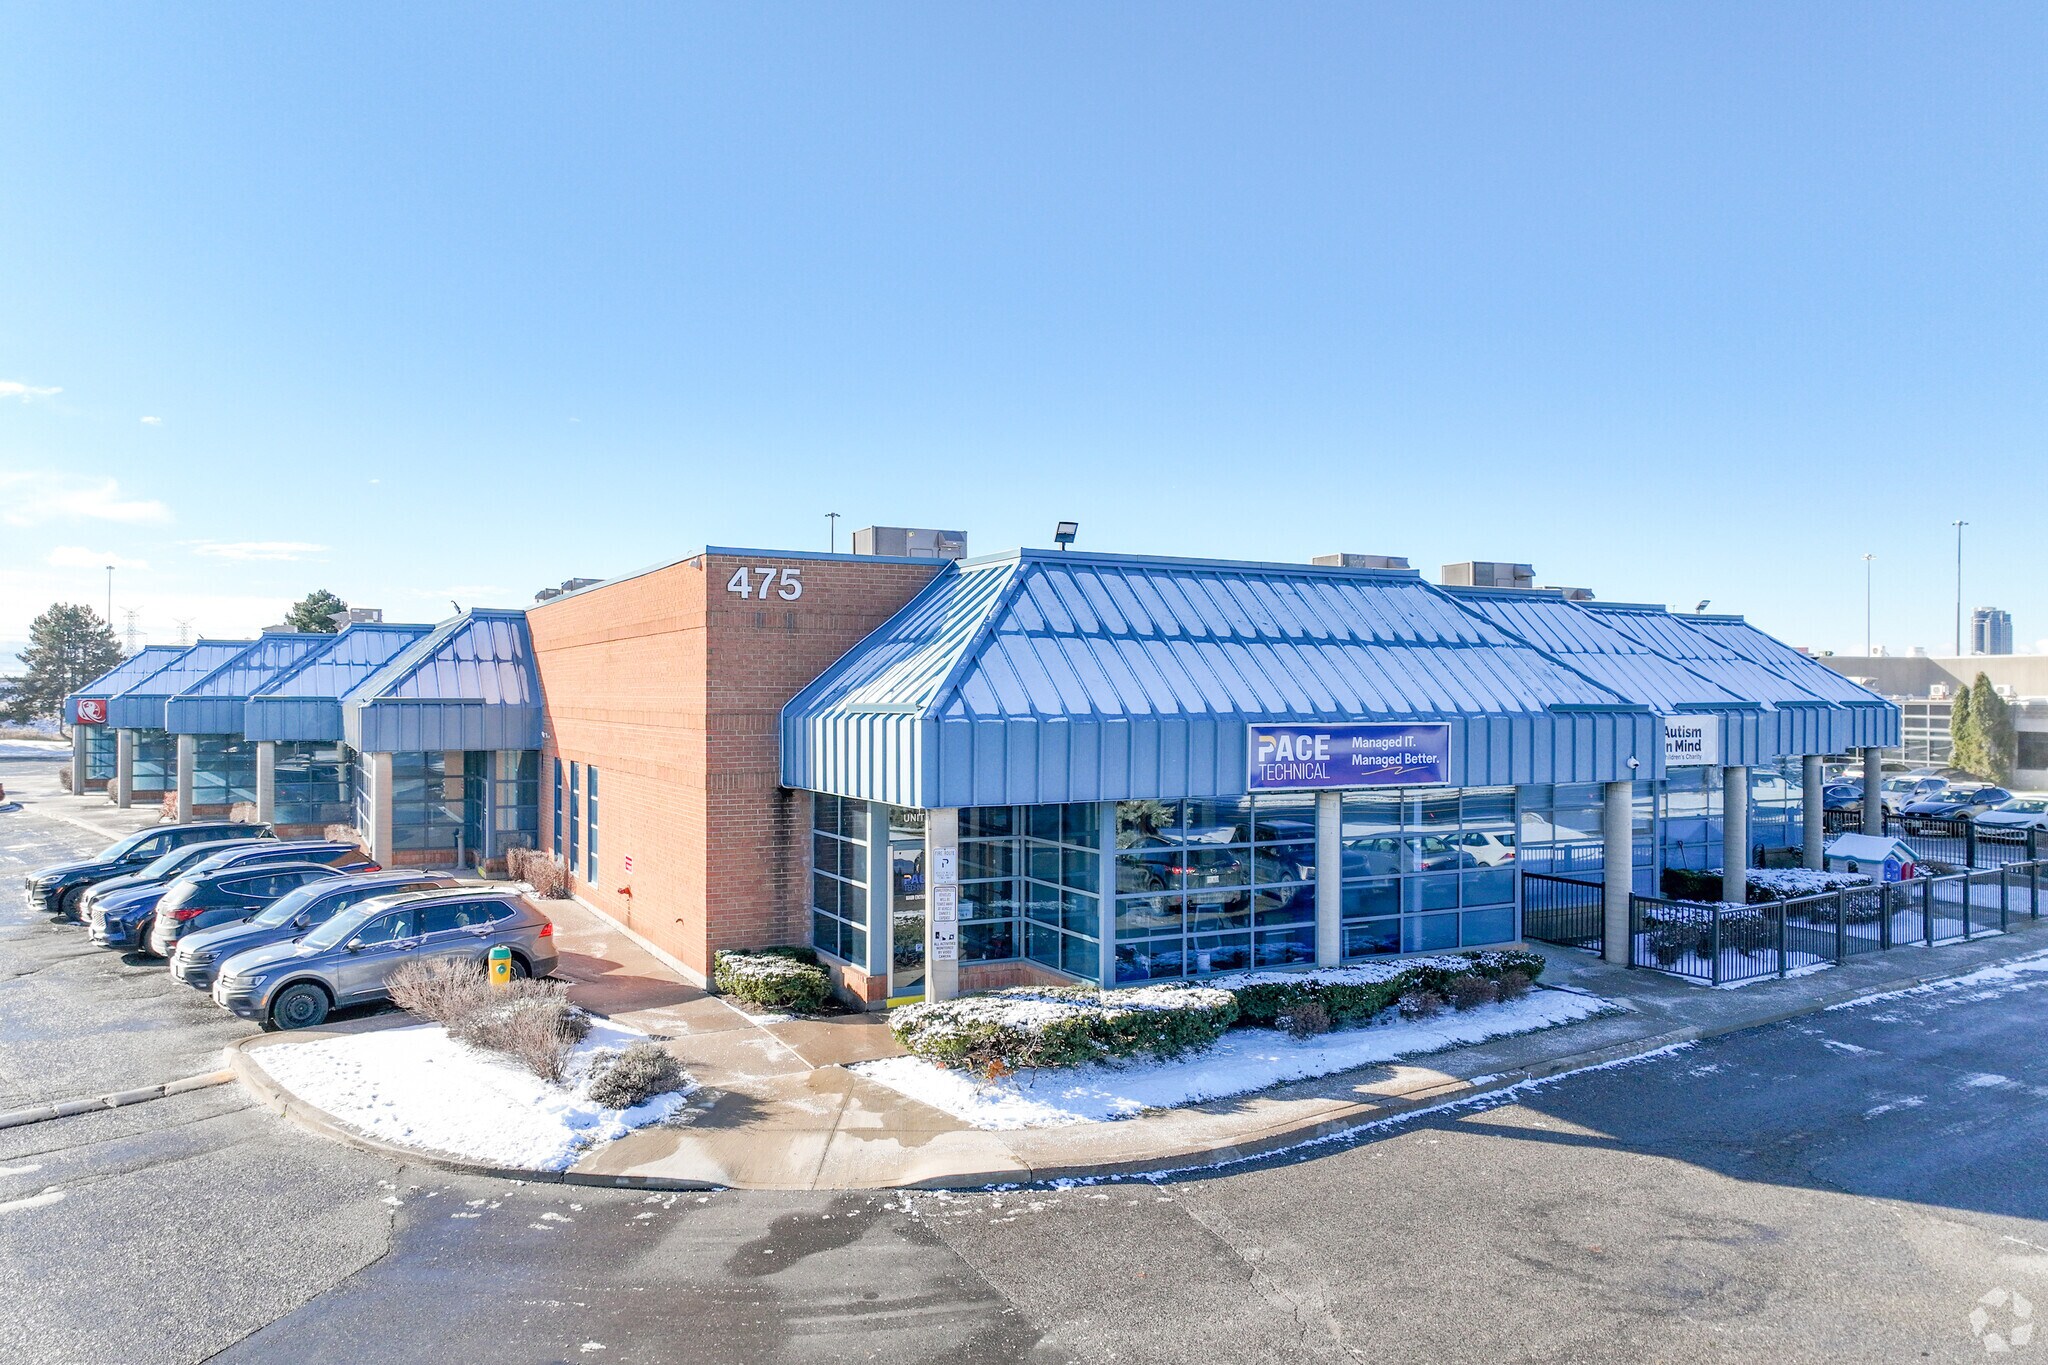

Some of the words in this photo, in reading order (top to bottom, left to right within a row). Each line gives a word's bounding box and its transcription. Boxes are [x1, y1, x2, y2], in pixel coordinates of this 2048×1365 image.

[727, 566, 803, 601] 475
[1258, 734, 1331, 762] PACE
[1352, 736, 1402, 751] Managed
[1405, 736, 1416, 747] IT.
[1675, 739, 1702, 752] Mind
[1352, 753, 1402, 768] Managed
[1405, 753, 1440, 764] Better.
[1258, 762, 1331, 781] TECHNICAL
[903, 813, 925, 822] UNIT
